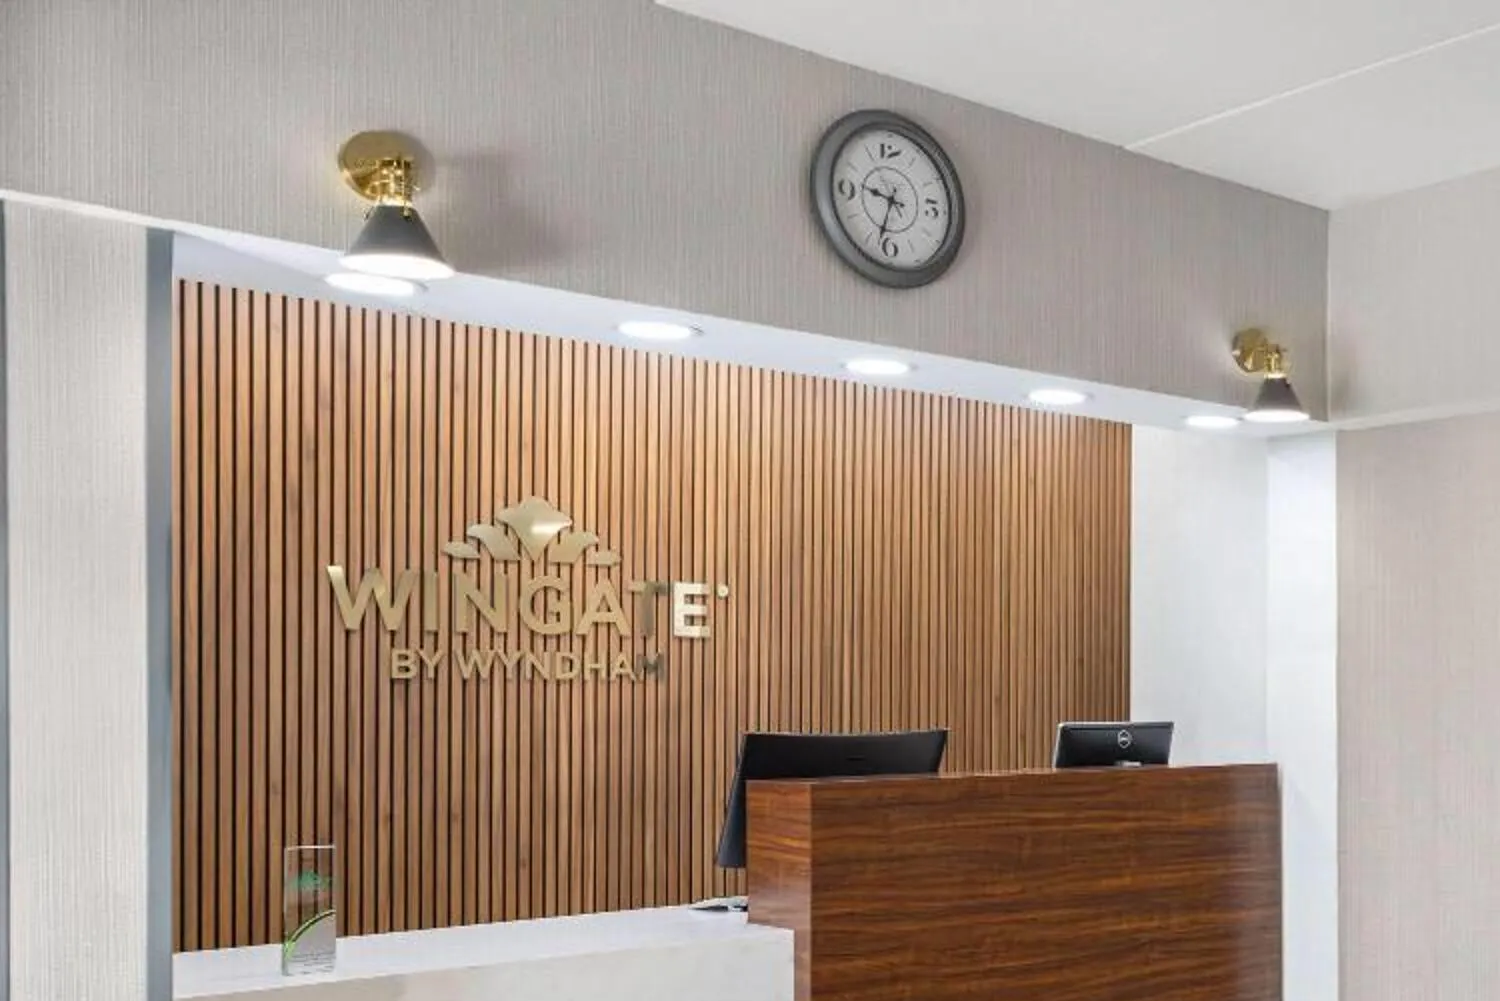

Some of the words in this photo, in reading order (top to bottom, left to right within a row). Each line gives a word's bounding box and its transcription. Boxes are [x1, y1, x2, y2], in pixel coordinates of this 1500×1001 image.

[837, 178, 856, 201] 9
[881, 237, 899, 257] 6
[326, 564, 712, 639] WINGATE
[391, 648, 444, 680] BY
[453, 649, 665, 682] WYNDHAM
